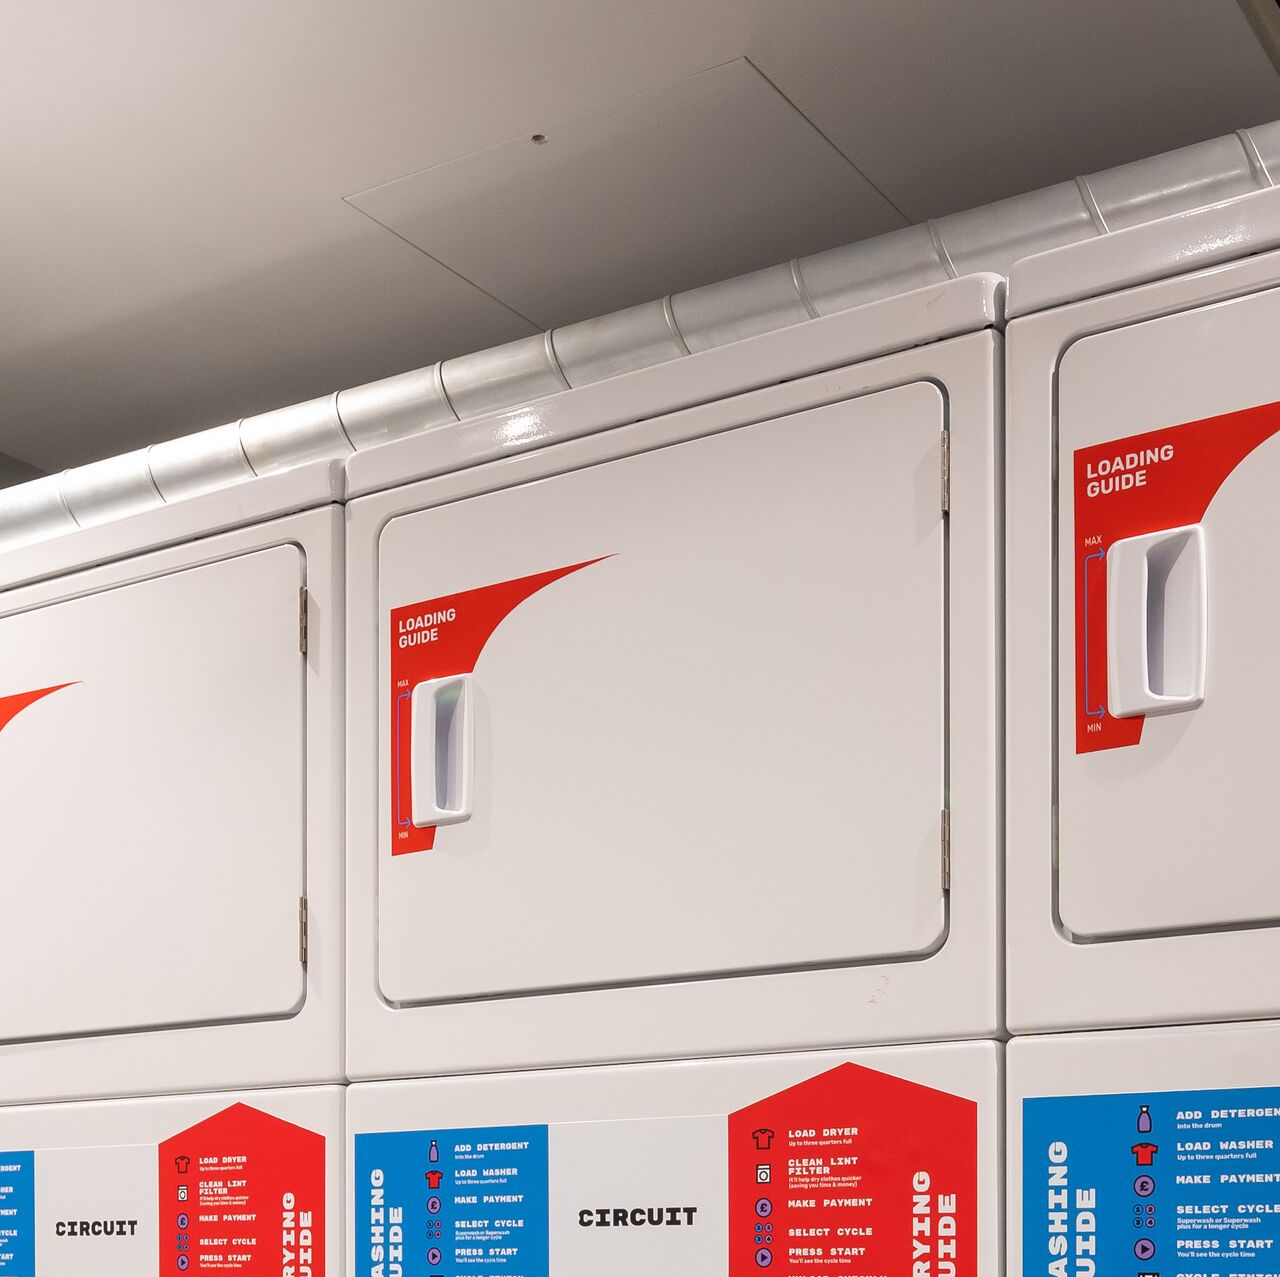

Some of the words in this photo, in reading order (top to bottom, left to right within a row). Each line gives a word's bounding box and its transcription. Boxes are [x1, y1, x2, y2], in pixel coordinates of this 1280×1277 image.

[1087, 444, 1173, 479] LOADING
[1086, 469, 1146, 497] GUIDE
[1084, 534, 1102, 546] MAX
[399, 608, 455, 633] LOADING
[398, 627, 438, 648] GUIDE
[397, 679, 408, 687] MAX
[1087, 722, 1101, 732] MIN
[398, 831, 408, 839] MIN
[1176, 1110, 1202, 1119] ADD
[788, 1129, 815, 1138] LOAD
[822, 1127, 858, 1136] DRYER
[454, 1144, 471, 1152] ADD
[476, 1141, 529, 1151] DETERGENT
[1177, 1141, 1211, 1151] LOAD
[1219, 1139, 1273, 1150] WASHER
[788, 1158, 822, 1167] CLEAN
[830, 1156, 858, 1165] LINT
[454, 1169, 477, 1177] LOAD
[482, 1167, 517, 1176] WASHER
[788, 1166, 830, 1175] FILTER
[1176, 1174, 1210, 1184] MAKE
[454, 1195, 477, 1203] MAKE
[483, 1194, 523, 1203] PAYMENT
[787, 1199, 815, 1207] MAKE
[823, 1198, 872, 1207] PAYMENT
[1176, 1204, 1228, 1214] SELECT
[578, 1206, 697, 1227] CIRCUIT
[55, 1219, 137, 1236] CIRCUIT
[454, 1220, 489, 1228] SELECT
[494, 1219, 523, 1227] CYCLE
[788, 1227, 830, 1236] SELECT
[837, 1227, 872, 1235] CYCLE
[1176, 1239, 1219, 1248] PRESS
[1229, 1239, 1273, 1248] START
[455, 1248, 483, 1256] PRESS
[489, 1247, 518, 1255] START
[788, 1247, 823, 1256] PRESS
[830, 1247, 865, 1255] START
